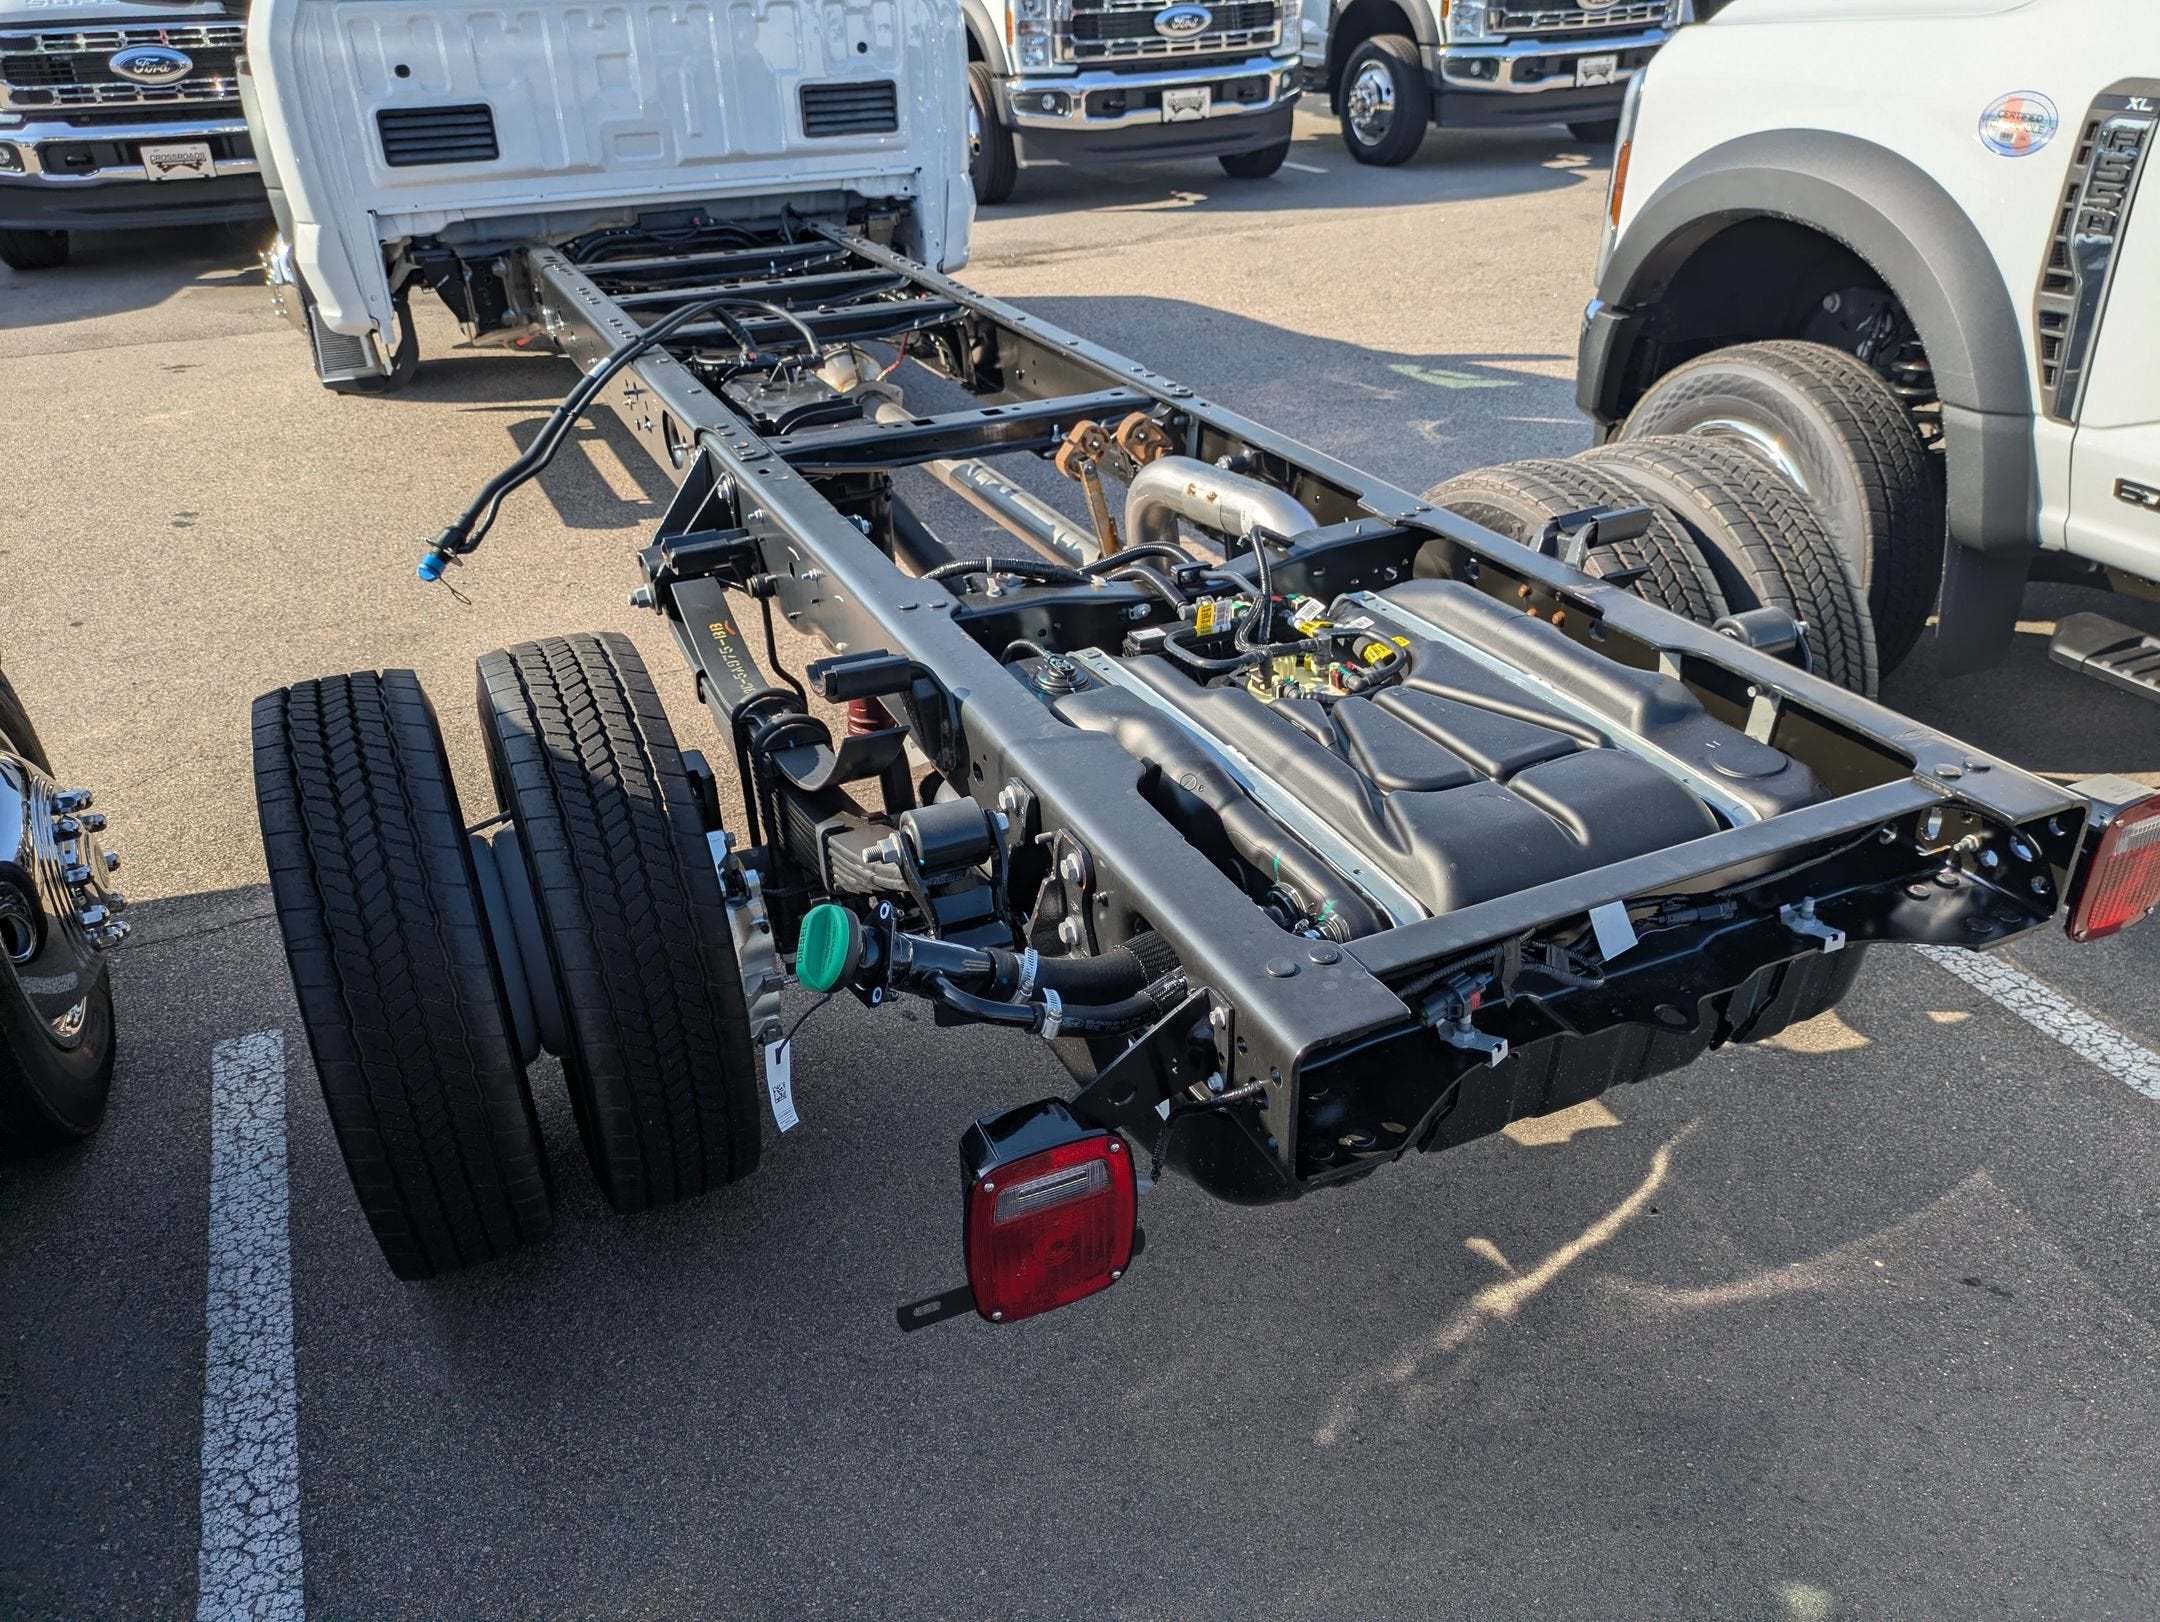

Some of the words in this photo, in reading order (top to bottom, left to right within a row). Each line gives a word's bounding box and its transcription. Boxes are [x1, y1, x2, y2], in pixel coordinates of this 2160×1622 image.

[1171, 16, 1200, 31] Ford
[133, 57, 171, 75] Ford
[2125, 97, 2153, 111] XL
[1997, 110, 2044, 123] CERTIFIED
[149, 152, 206, 164] CROSSROADS
[797, 922, 809, 965] DIESEL
